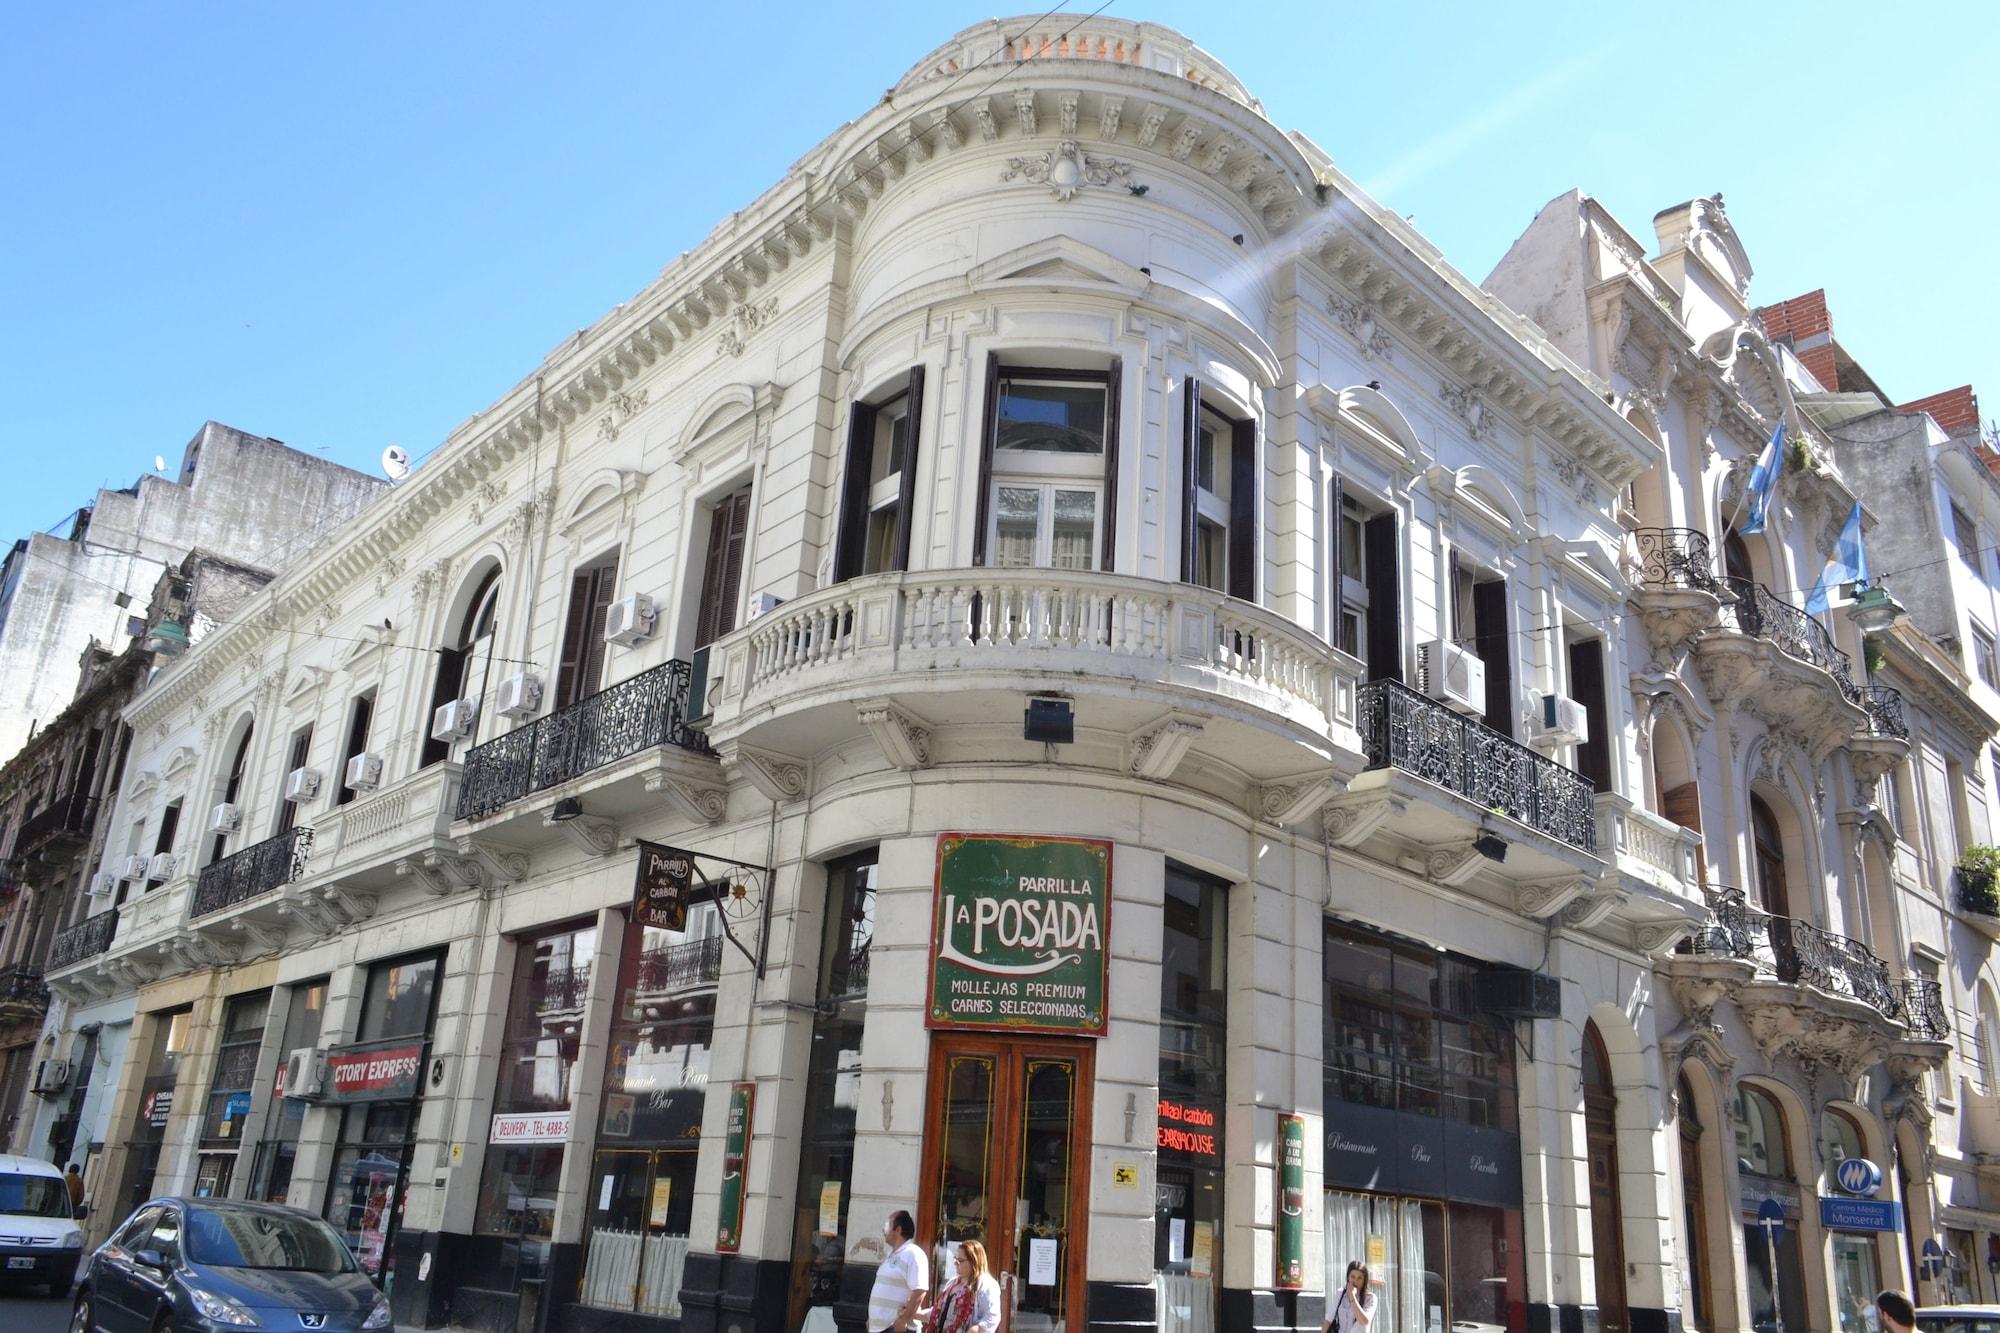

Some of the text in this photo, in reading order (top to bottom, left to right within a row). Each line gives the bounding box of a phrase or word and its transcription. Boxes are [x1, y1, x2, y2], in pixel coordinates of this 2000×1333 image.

[648, 854, 689, 878] PARRILLA
[649, 887, 678, 898] CARBON
[1019, 876, 1092, 895] PARRILLA
[650, 908, 667, 924] BAR
[974, 897, 1101, 954] POSADA
[951, 980, 1086, 999] MOLLEJAS PREMIUM
[951, 999, 1087, 1019] CARNES SELECCIONADAS
[368, 1057, 417, 1080] EXPRESS
[649, 1088, 673, 1109] Bar
[500, 1120, 528, 1136] DELIVERY
[1327, 1131, 1377, 1155] Restaurante
[1411, 1143, 1432, 1163] Bar
[1831, 1203, 1856, 1212] Centro
[1832, 1213, 1885, 1226] Monserrat
